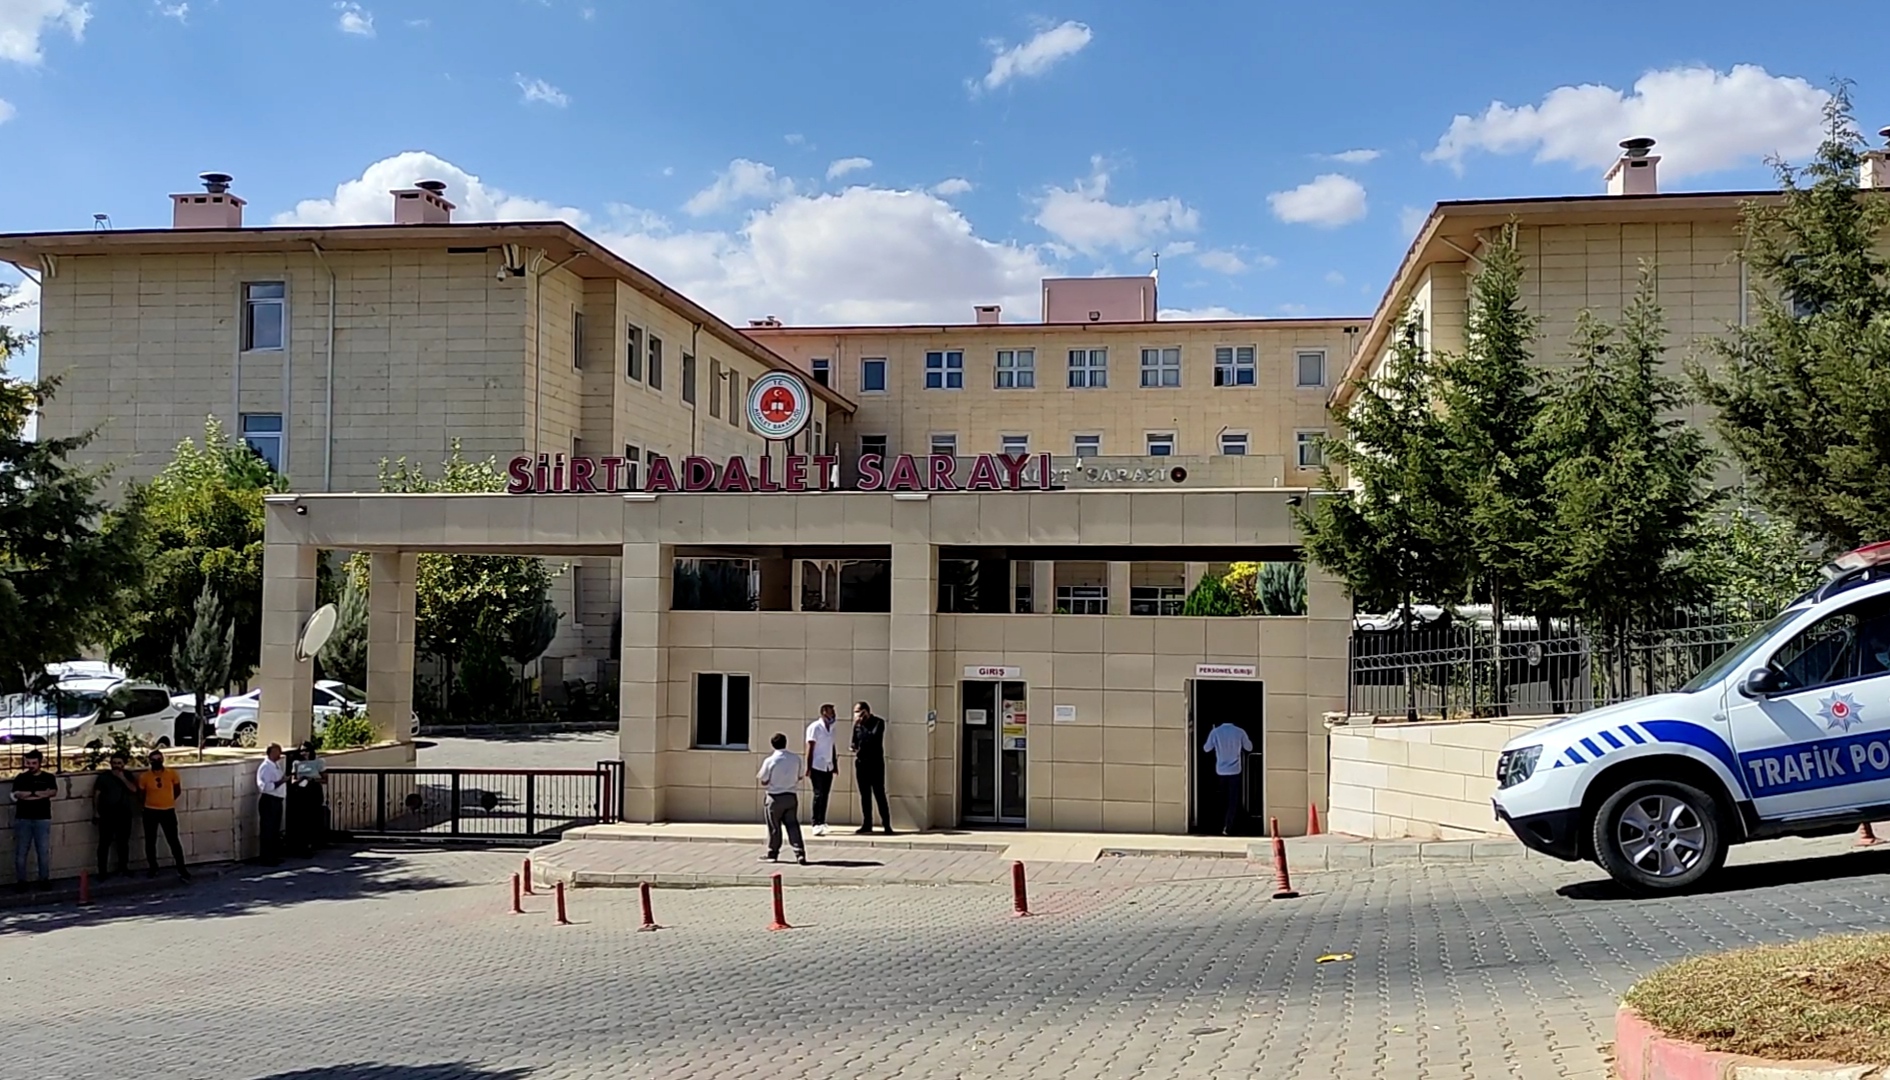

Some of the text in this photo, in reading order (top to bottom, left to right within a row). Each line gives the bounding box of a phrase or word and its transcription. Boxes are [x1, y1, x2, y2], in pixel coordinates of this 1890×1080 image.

[645, 455, 837, 493] ADALET
[857, 453, 1052, 491] SARAYI
[1086, 467, 1168, 483] SARAYI
[979, 668, 1005, 677] GİRİŞ
[1199, 667, 1232, 675] PERSONEL
[1748, 741, 1890, 788] TRAFİK PO
